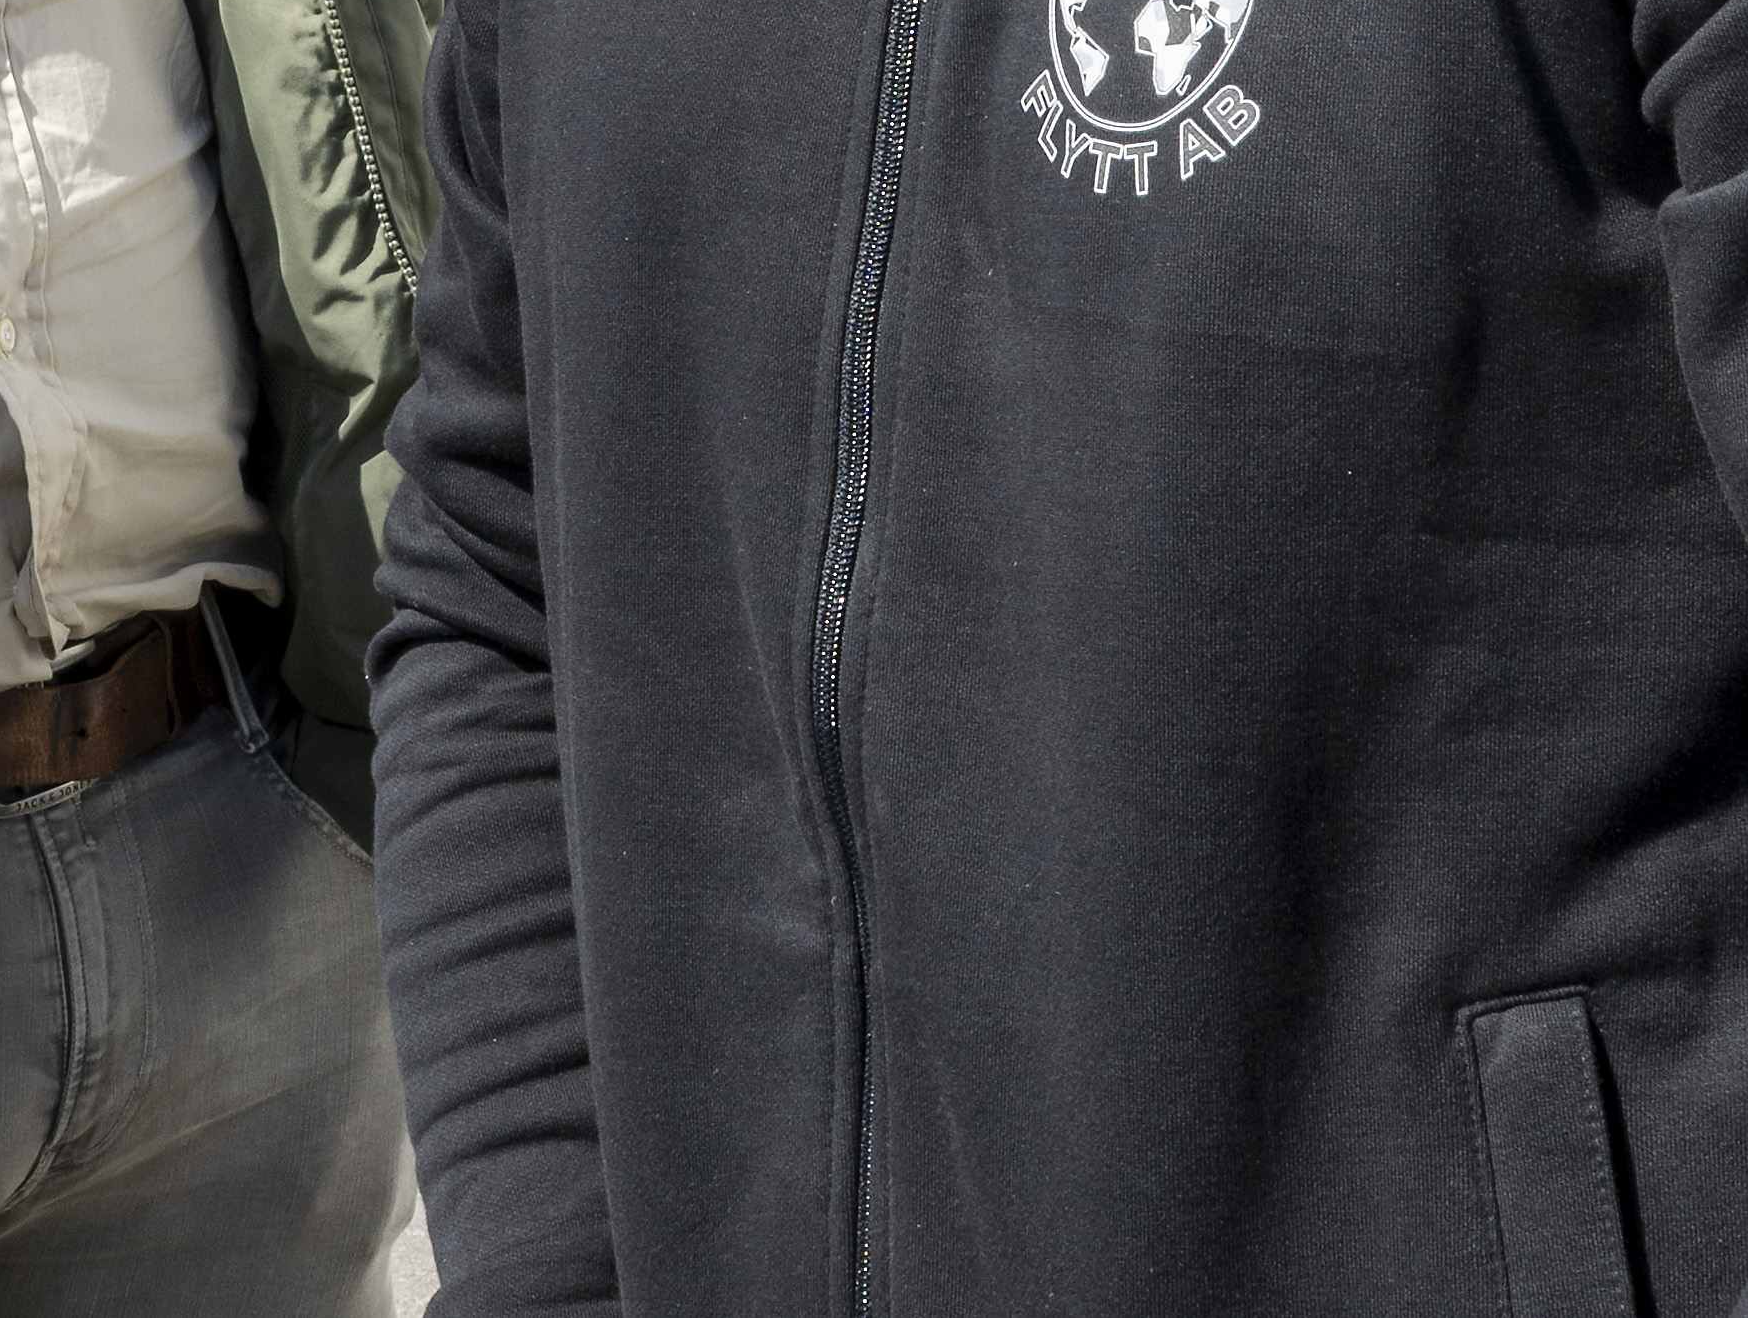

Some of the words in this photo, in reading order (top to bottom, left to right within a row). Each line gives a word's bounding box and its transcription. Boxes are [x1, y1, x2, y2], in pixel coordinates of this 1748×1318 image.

[1021, 69, 1159, 197] FLYTT
[1178, 84, 1261, 182] AB
[15, 797, 46, 813] JACK
